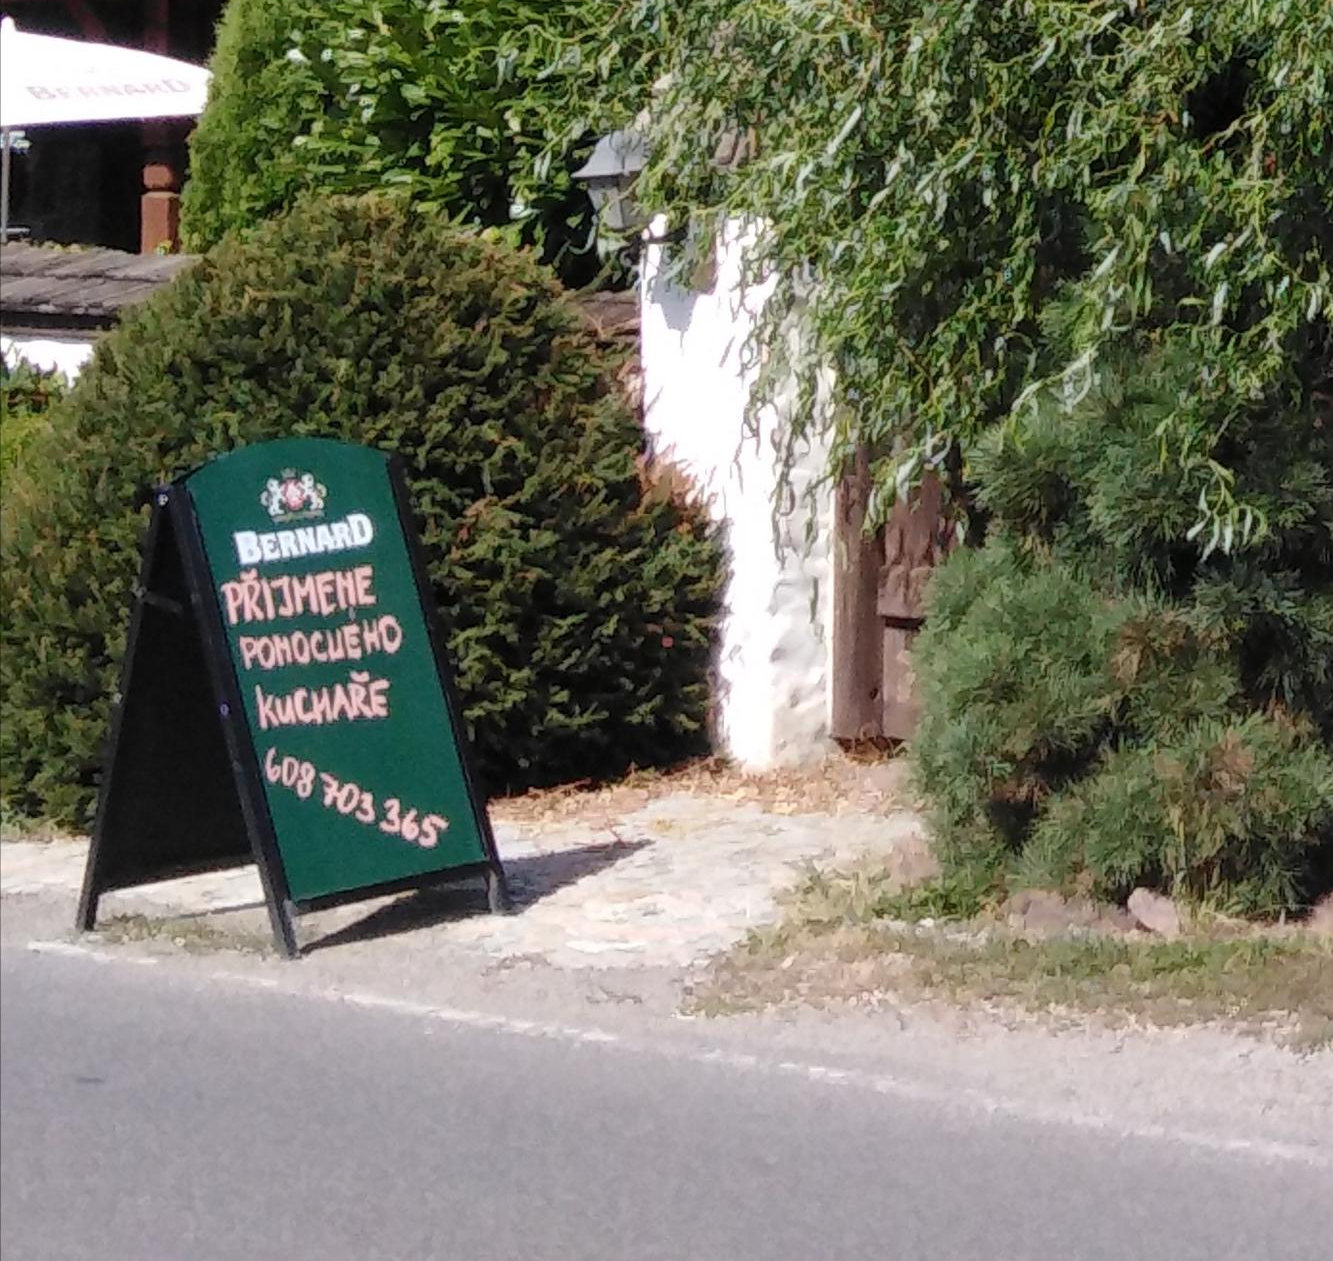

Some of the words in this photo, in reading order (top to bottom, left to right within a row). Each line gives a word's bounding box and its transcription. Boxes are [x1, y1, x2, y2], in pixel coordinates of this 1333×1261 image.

[233, 513, 374, 565] BERNARD
[265, 747, 316, 798] 608
[320, 772, 375, 823] 703
[379, 798, 449, 847] 365
